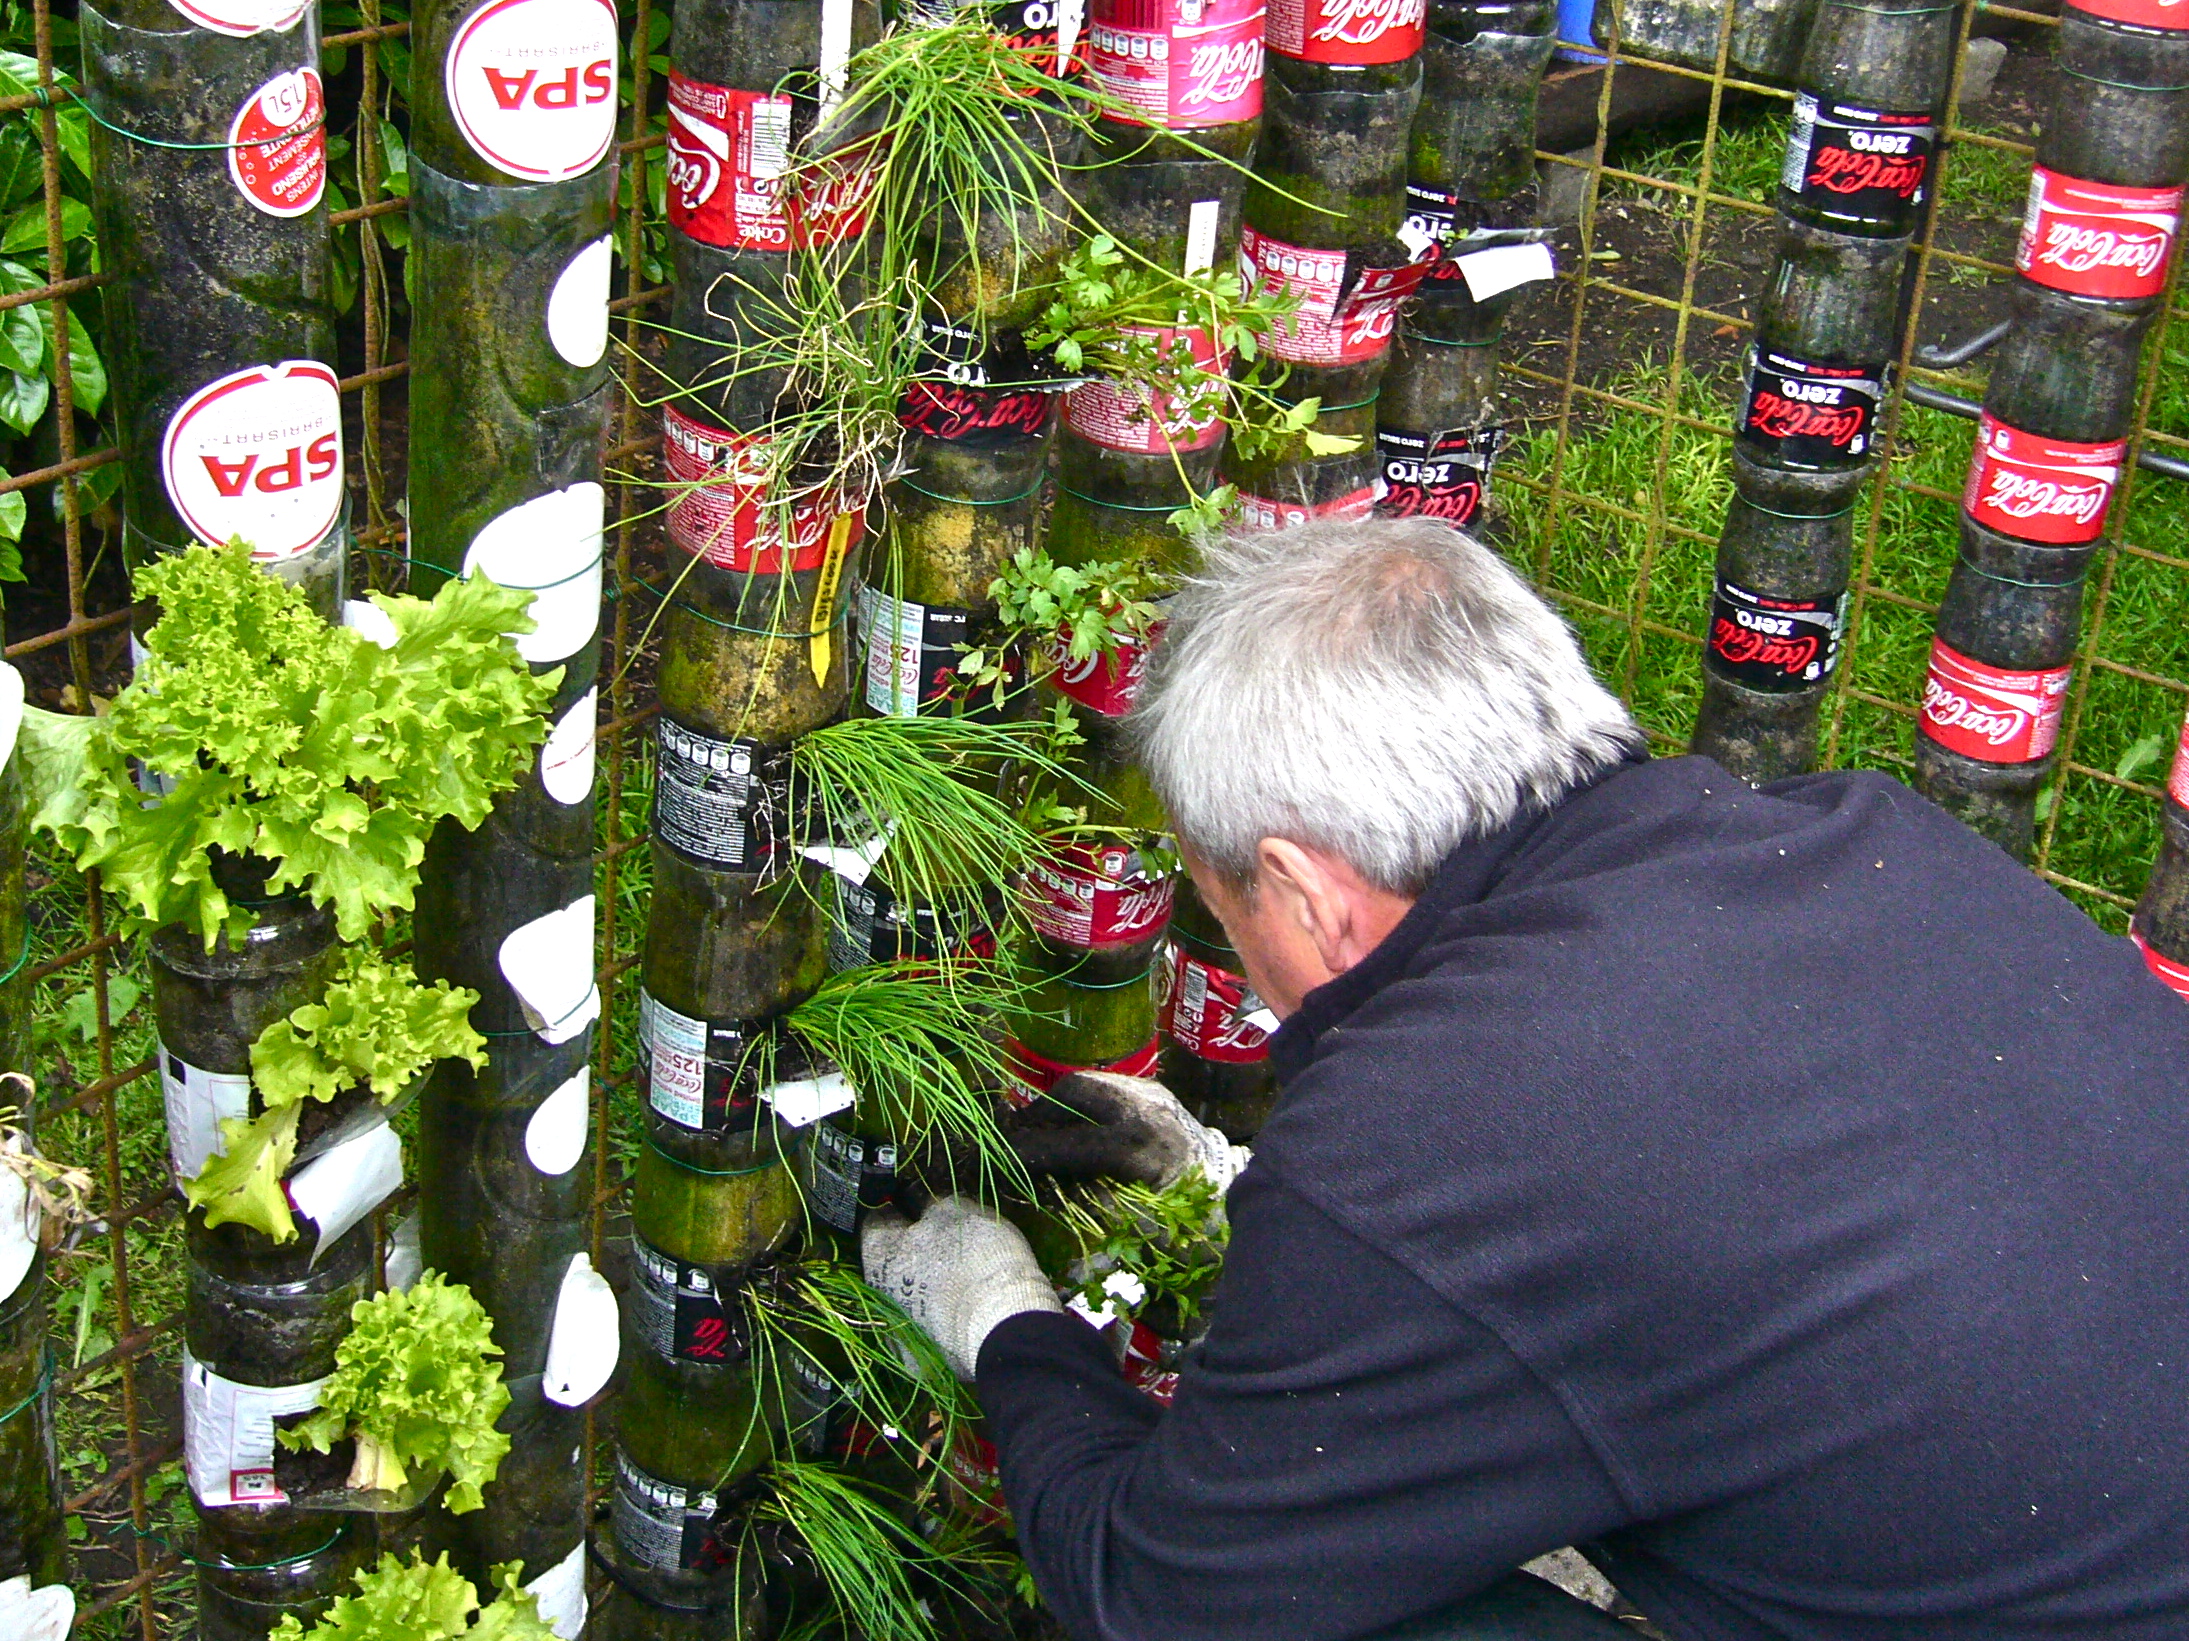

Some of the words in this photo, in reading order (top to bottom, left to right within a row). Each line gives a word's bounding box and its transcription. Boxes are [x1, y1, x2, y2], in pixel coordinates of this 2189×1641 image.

[481, 59, 612, 111] SPA
[1848, 130, 1911, 154] zero
[286, 169, 319, 203] INTENS
[1806, 147, 1926, 198] Coca-Cola
[739, 224, 786, 244] Coke
[2037, 221, 2167, 278] Coca-Cola
[1780, 378, 1842, 405] zero
[1749, 390, 1865, 447] Coca-Cola
[198, 430, 338, 498] SPA
[1387, 462, 1451, 484] zero
[1981, 468, 2107, 525] Coca-Cola
[1711, 618, 1818, 674] Coca-Cola
[1735, 608, 1793, 636] zero
[1922, 678, 2025, 745] Coca-Cola
[672, 1054, 702, 1076] 125
